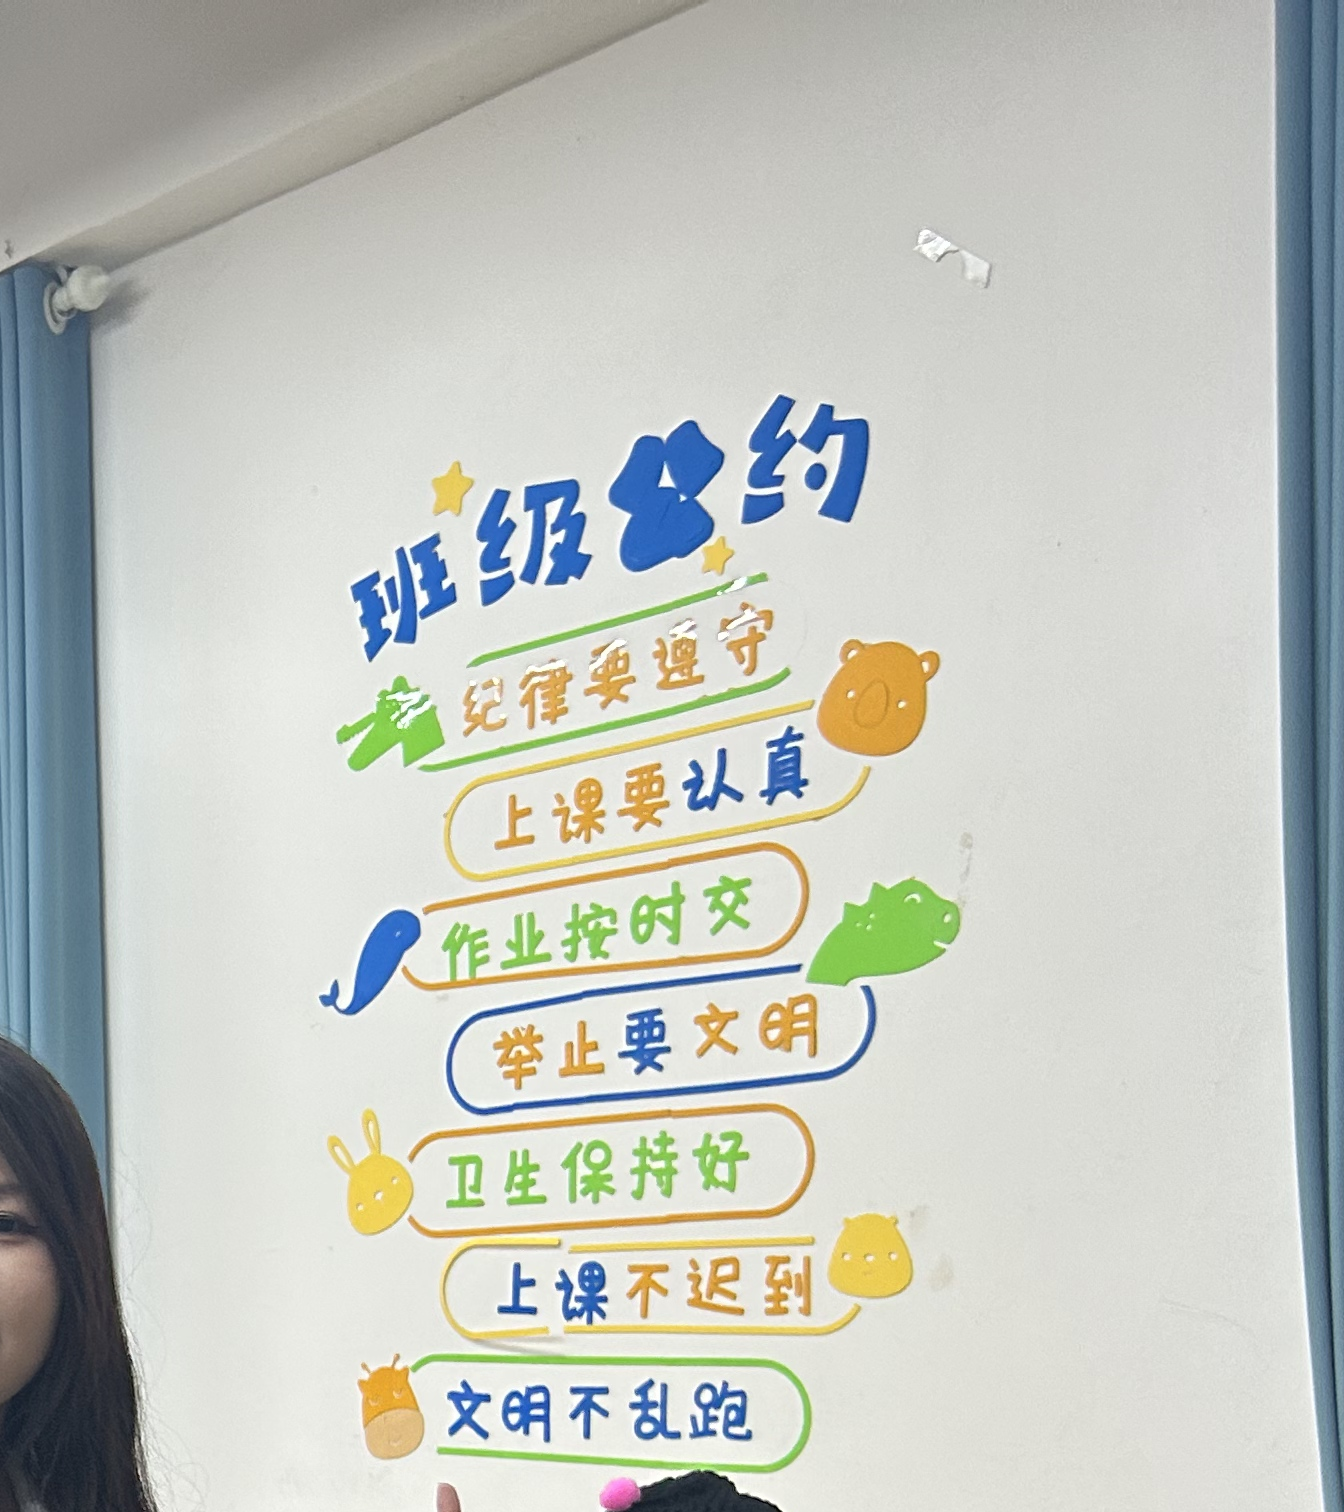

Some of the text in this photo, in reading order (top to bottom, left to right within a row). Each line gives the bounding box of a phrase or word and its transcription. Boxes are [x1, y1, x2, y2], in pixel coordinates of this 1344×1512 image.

[462, 601, 775, 737] 纪律要遵守
[493, 725, 810, 850] 上课要认真
[441, 874, 752, 982] 作业按时交
[492, 992, 819, 1090] 举止要文明
[445, 1130, 751, 1209] 卫生保持好
[496, 1254, 813, 1325] 上课不迟到
[446, 1378, 754, 1443] 文明不乱跑
